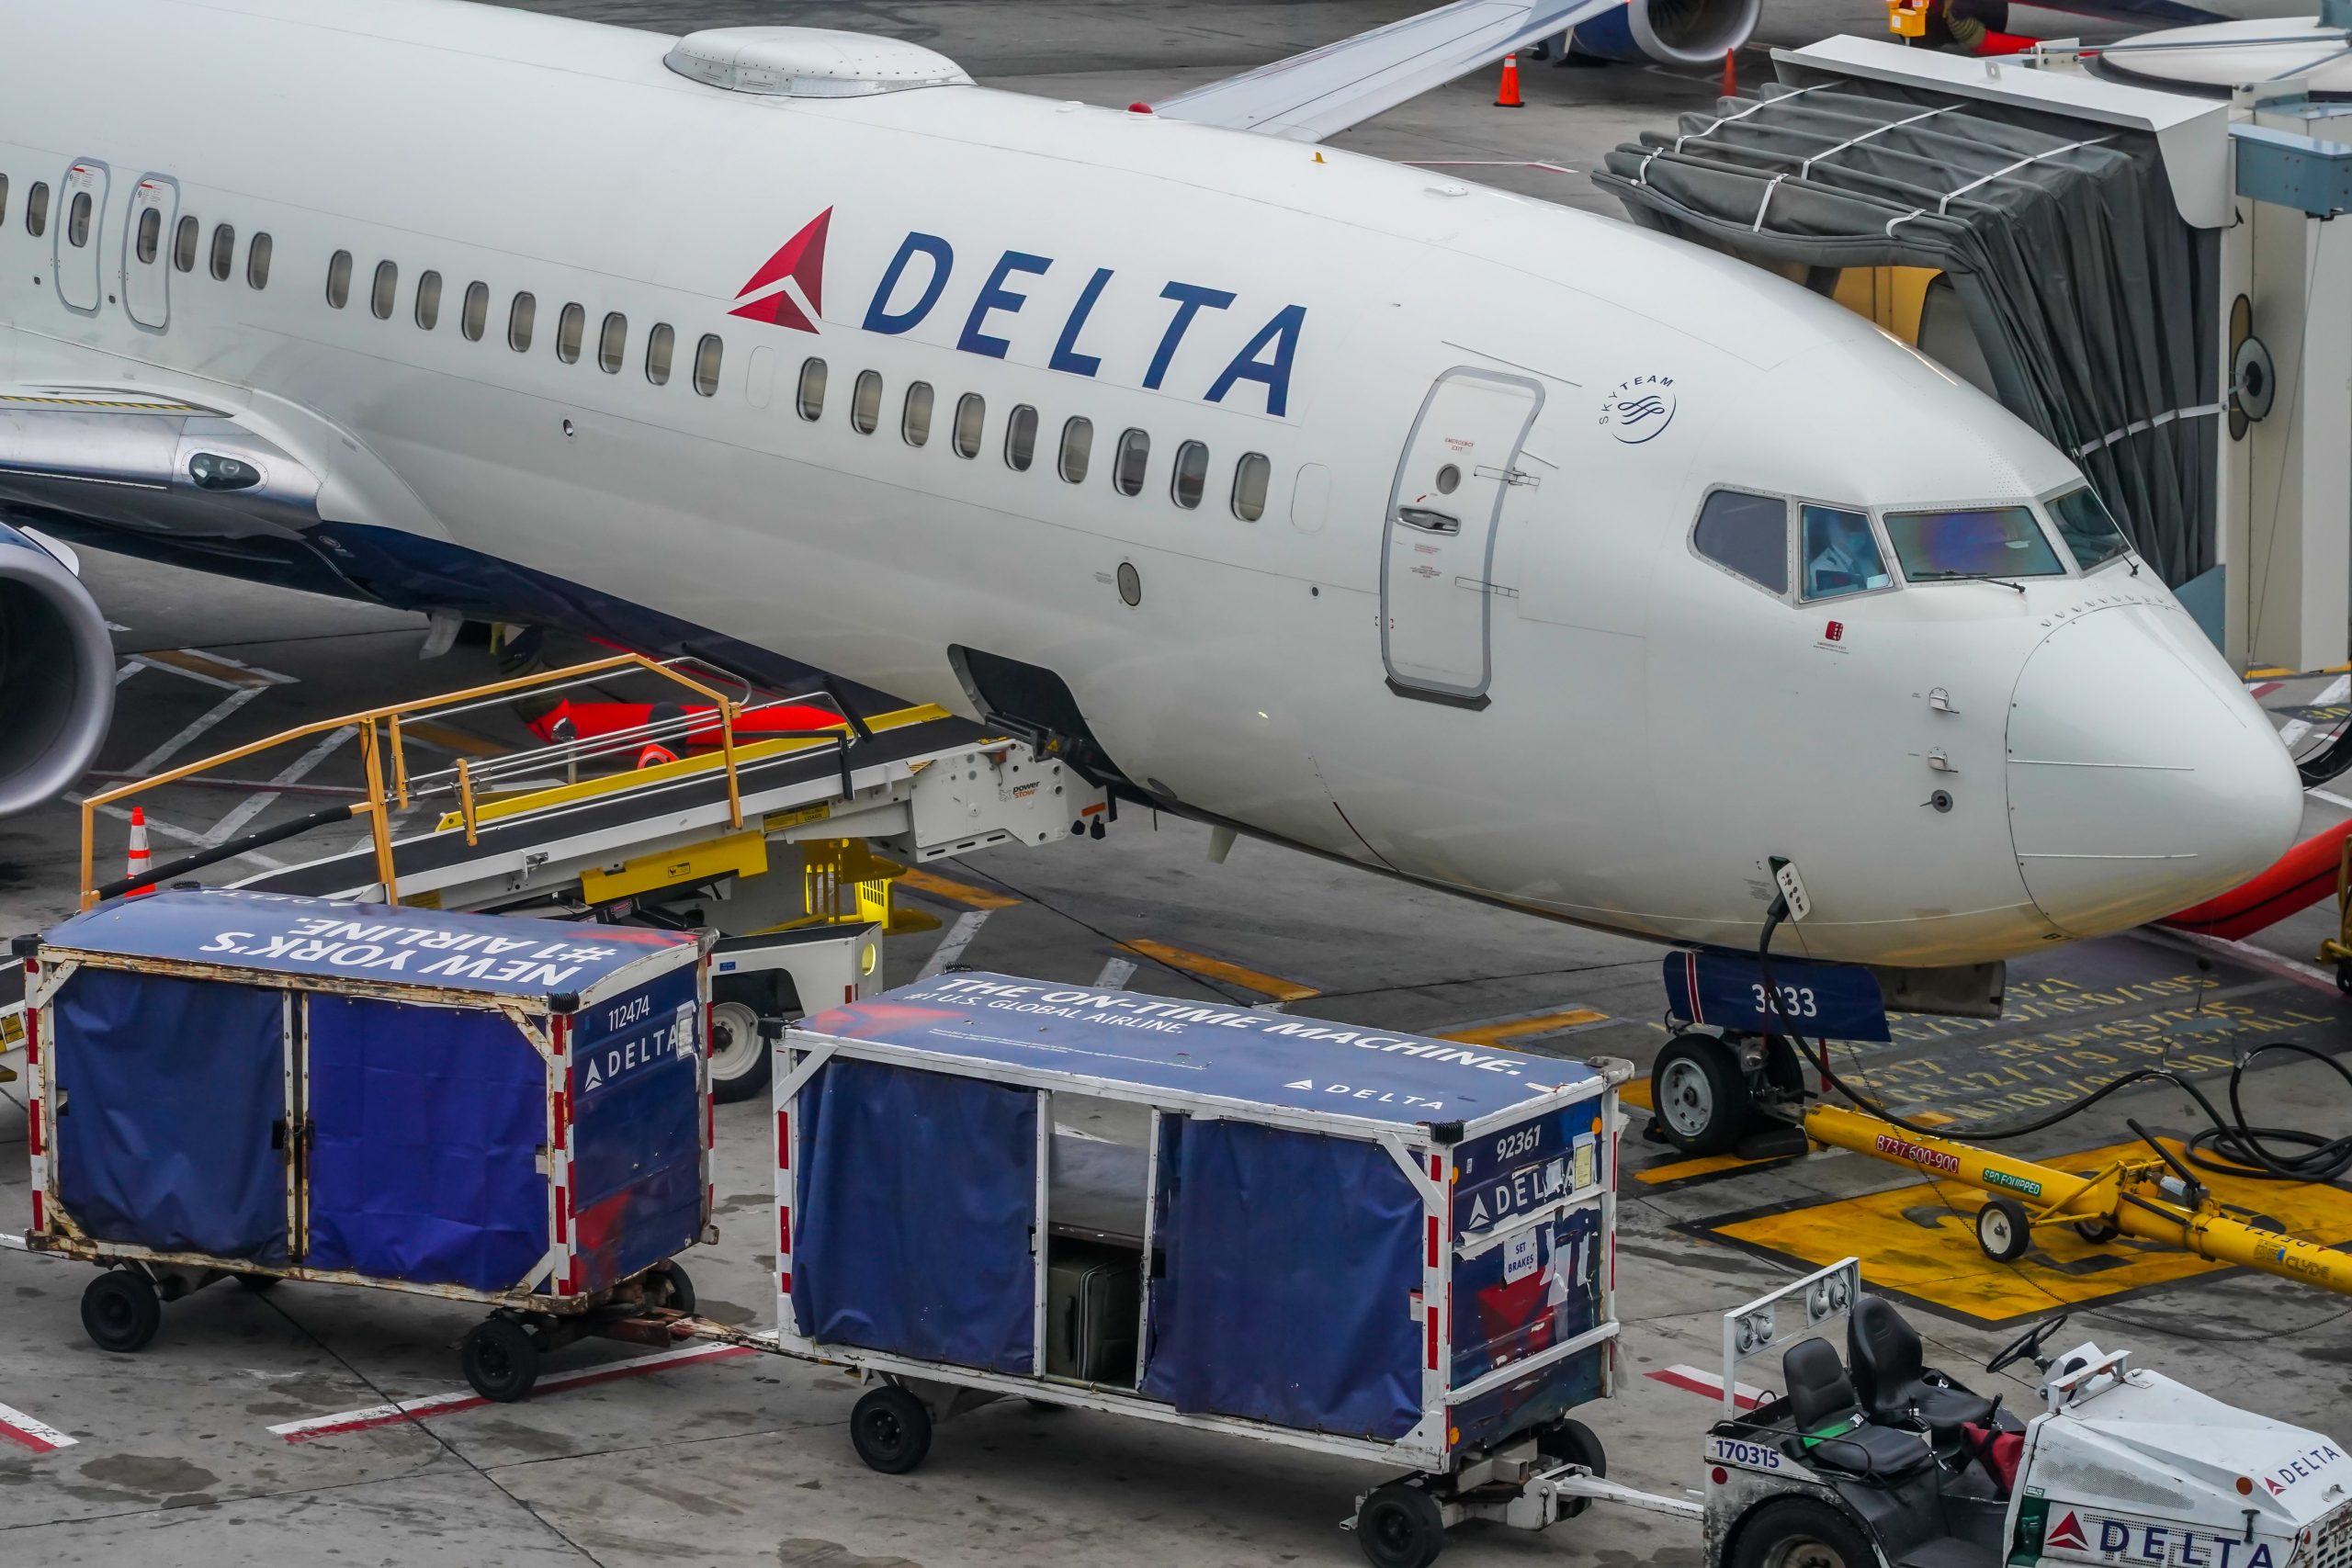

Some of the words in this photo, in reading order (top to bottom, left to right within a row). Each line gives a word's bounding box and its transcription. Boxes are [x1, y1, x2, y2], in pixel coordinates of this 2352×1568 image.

[862, 231, 1307, 417] DELTA
[1599, 375, 1674, 425] SKYTEAM
[1444, 436, 1475, 448] EMERGENCY
[1012, 781, 1041, 795] power
[1013, 789, 1036, 799] stow
[198, 931, 418, 971] YORK'S
[288, 917, 529, 955] AIRLINE.
[528, 943, 617, 964] #1
[418, 953, 583, 987] NEW
[608, 994, 650, 1032] 112474
[903, 991, 933, 1000] #1
[937, 993, 978, 1006] U.S.
[987, 999, 1079, 1019] GLOBAL
[1084, 1011, 1188, 1034] AIRLINE.
[934, 977, 1046, 998] THE
[1041, 989, 1272, 1030] ON-TIME
[1261, 1021, 1528, 1076] MACHINE.
[608, 1024, 678, 1077] DELTA
[1323, 1084, 1444, 1111] DELTA
[1496, 1123, 1542, 1163] 92361
[1876, 1134, 1908, 1156] B737
[1908, 1145, 1959, 1173] 600-900
[1496, 1159, 1574, 1215] DELA
[2000, 1174, 2041, 1195] EQUIPPED
[1508, 1254, 1534, 1273] BRAKES
[1515, 1241, 1526, 1255] SET
[2285, 1256, 2330, 1280] CLYDE
[1715, 1439, 1780, 1469] 170315
[2278, 1445, 2341, 1484] DELTA
[2099, 1519, 2275, 1568] DELTA
